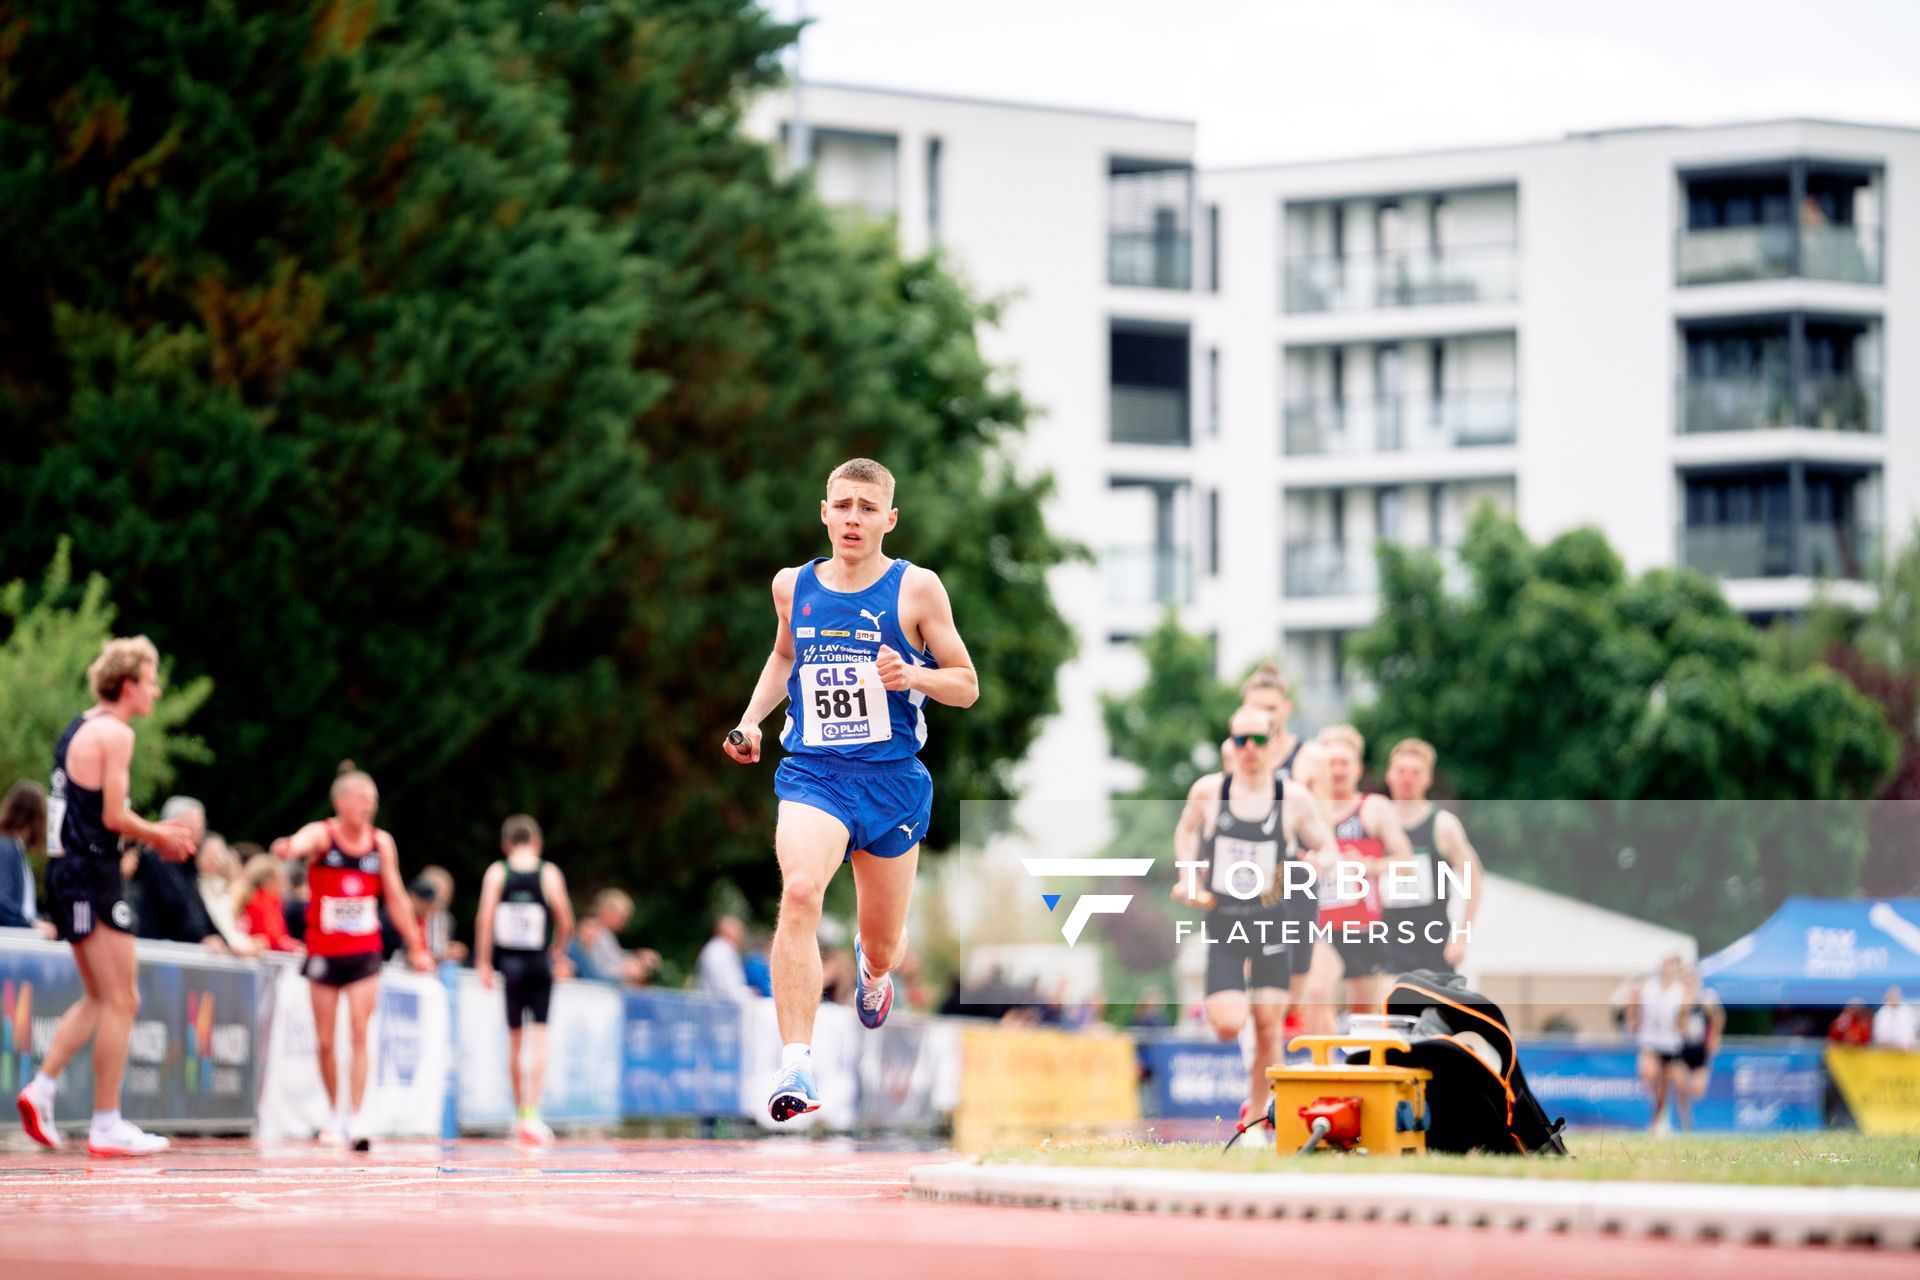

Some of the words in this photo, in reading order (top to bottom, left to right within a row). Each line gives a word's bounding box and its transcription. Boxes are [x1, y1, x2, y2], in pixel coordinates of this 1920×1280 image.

[856, 632, 875, 641] gmg
[819, 644, 840, 652] LAV
[820, 653, 872, 663] TÜBINGEN
[815, 688, 868, 719] 581
[840, 723, 868, 733] PLAN
